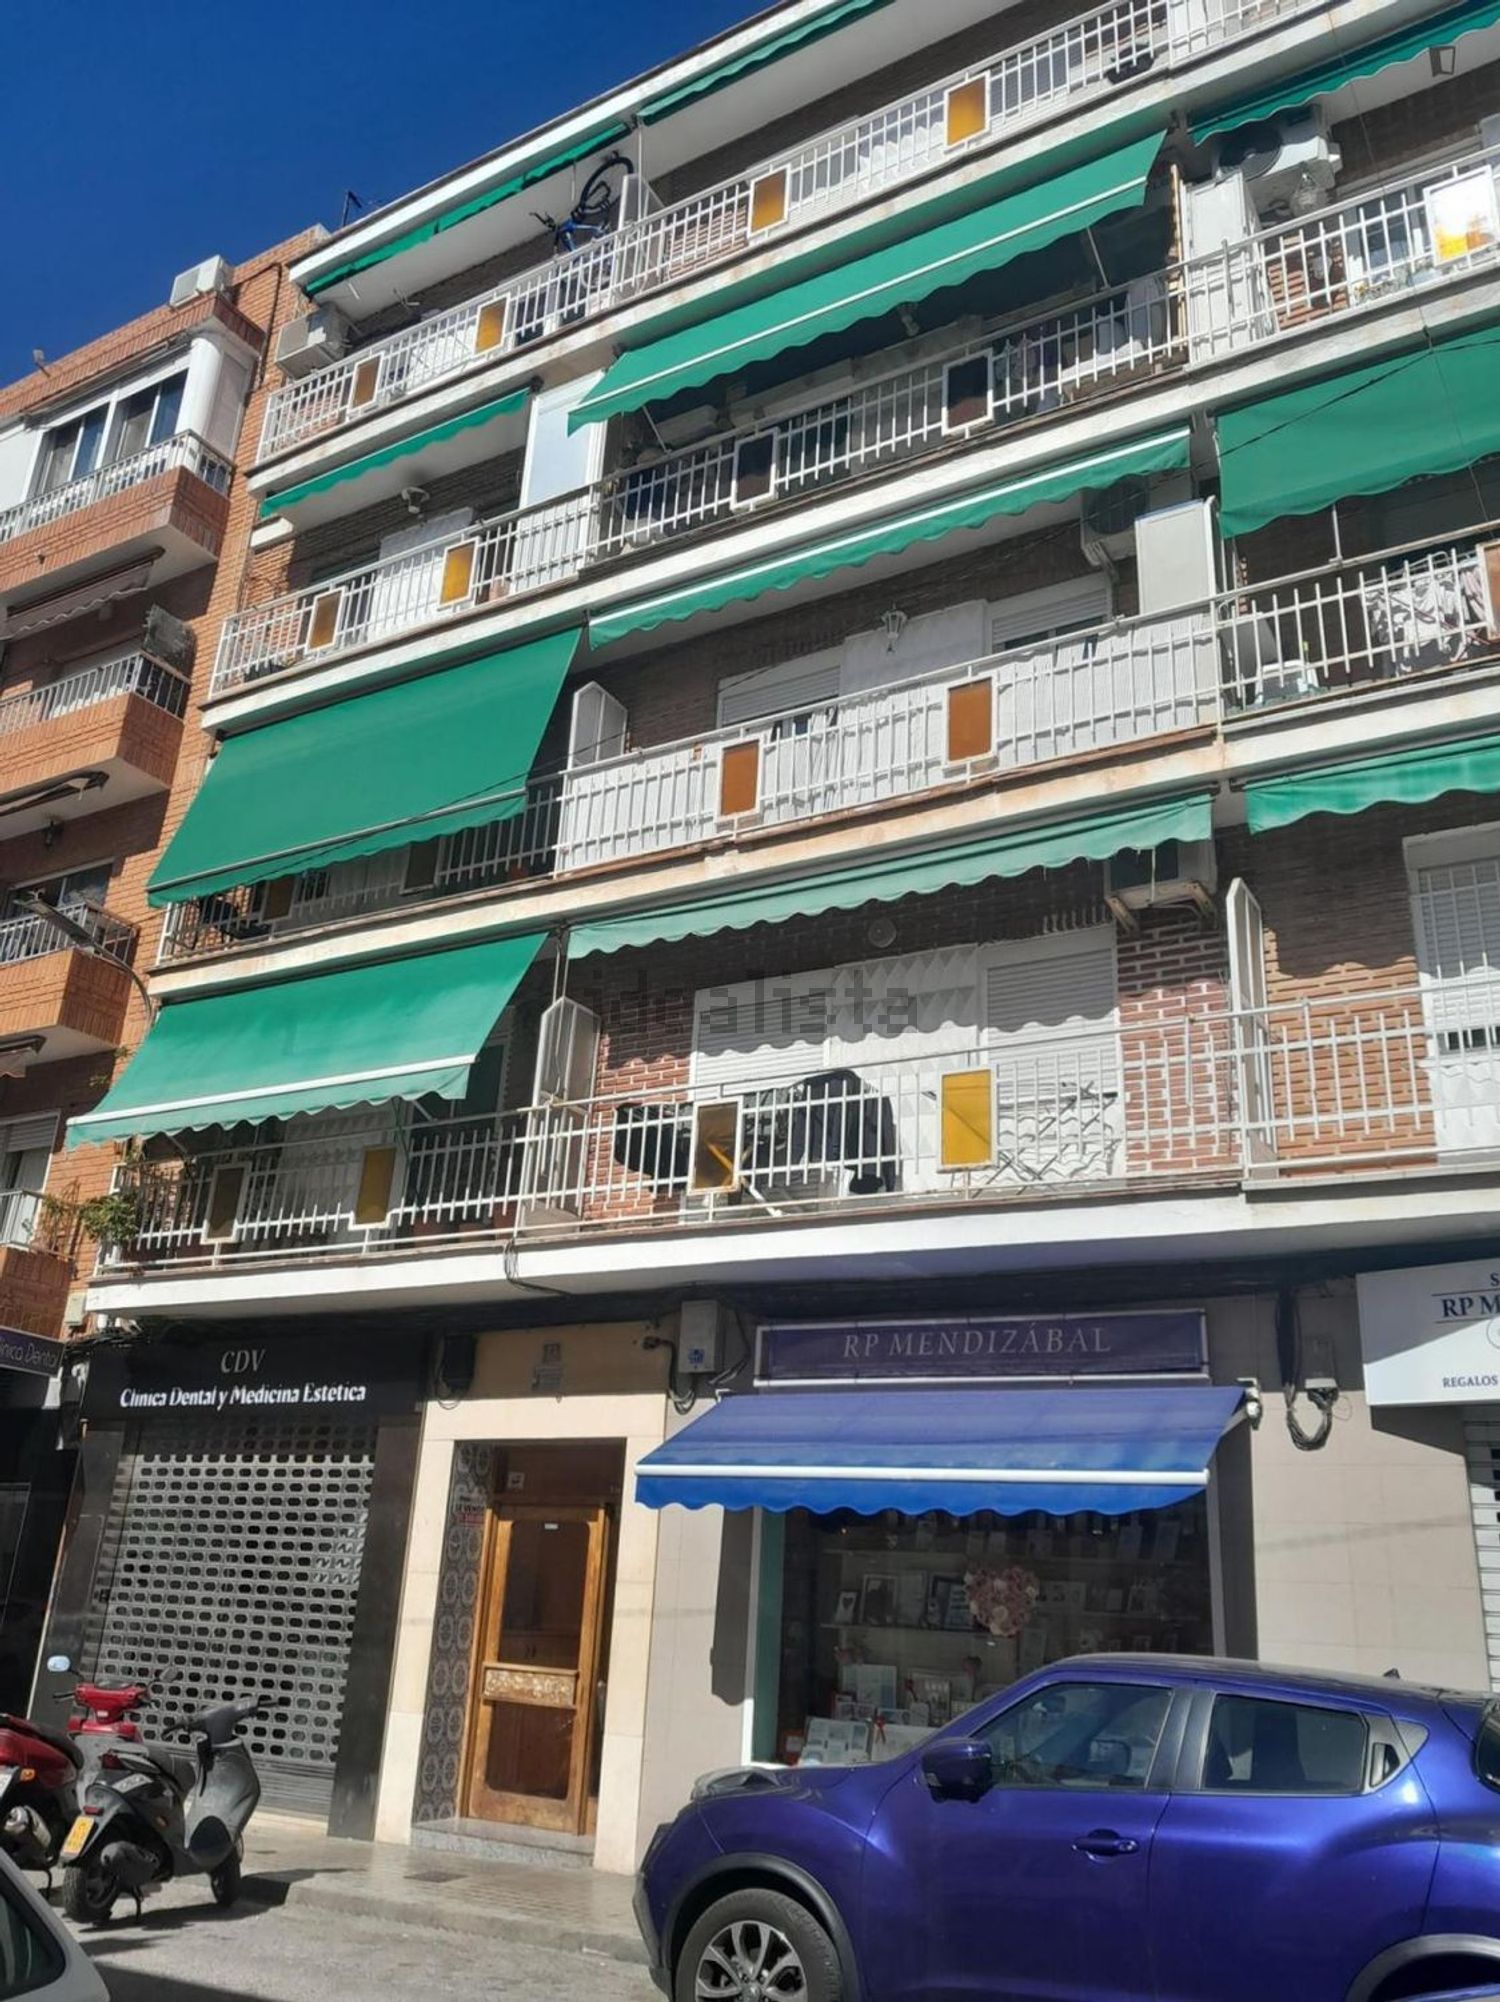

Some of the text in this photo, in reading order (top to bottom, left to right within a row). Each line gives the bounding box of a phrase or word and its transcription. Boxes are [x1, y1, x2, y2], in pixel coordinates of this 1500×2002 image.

[1442, 1297, 1474, 1318] RP
[843, 1321, 1112, 1358] RP MENDIZÁBAL
[220, 1349, 266, 1374] CDV
[1442, 1375, 1499, 1388] REGALOS
[169, 1385, 217, 1406] Dental
[217, 1390, 229, 1411] y
[230, 1383, 300, 1405] Medicina
